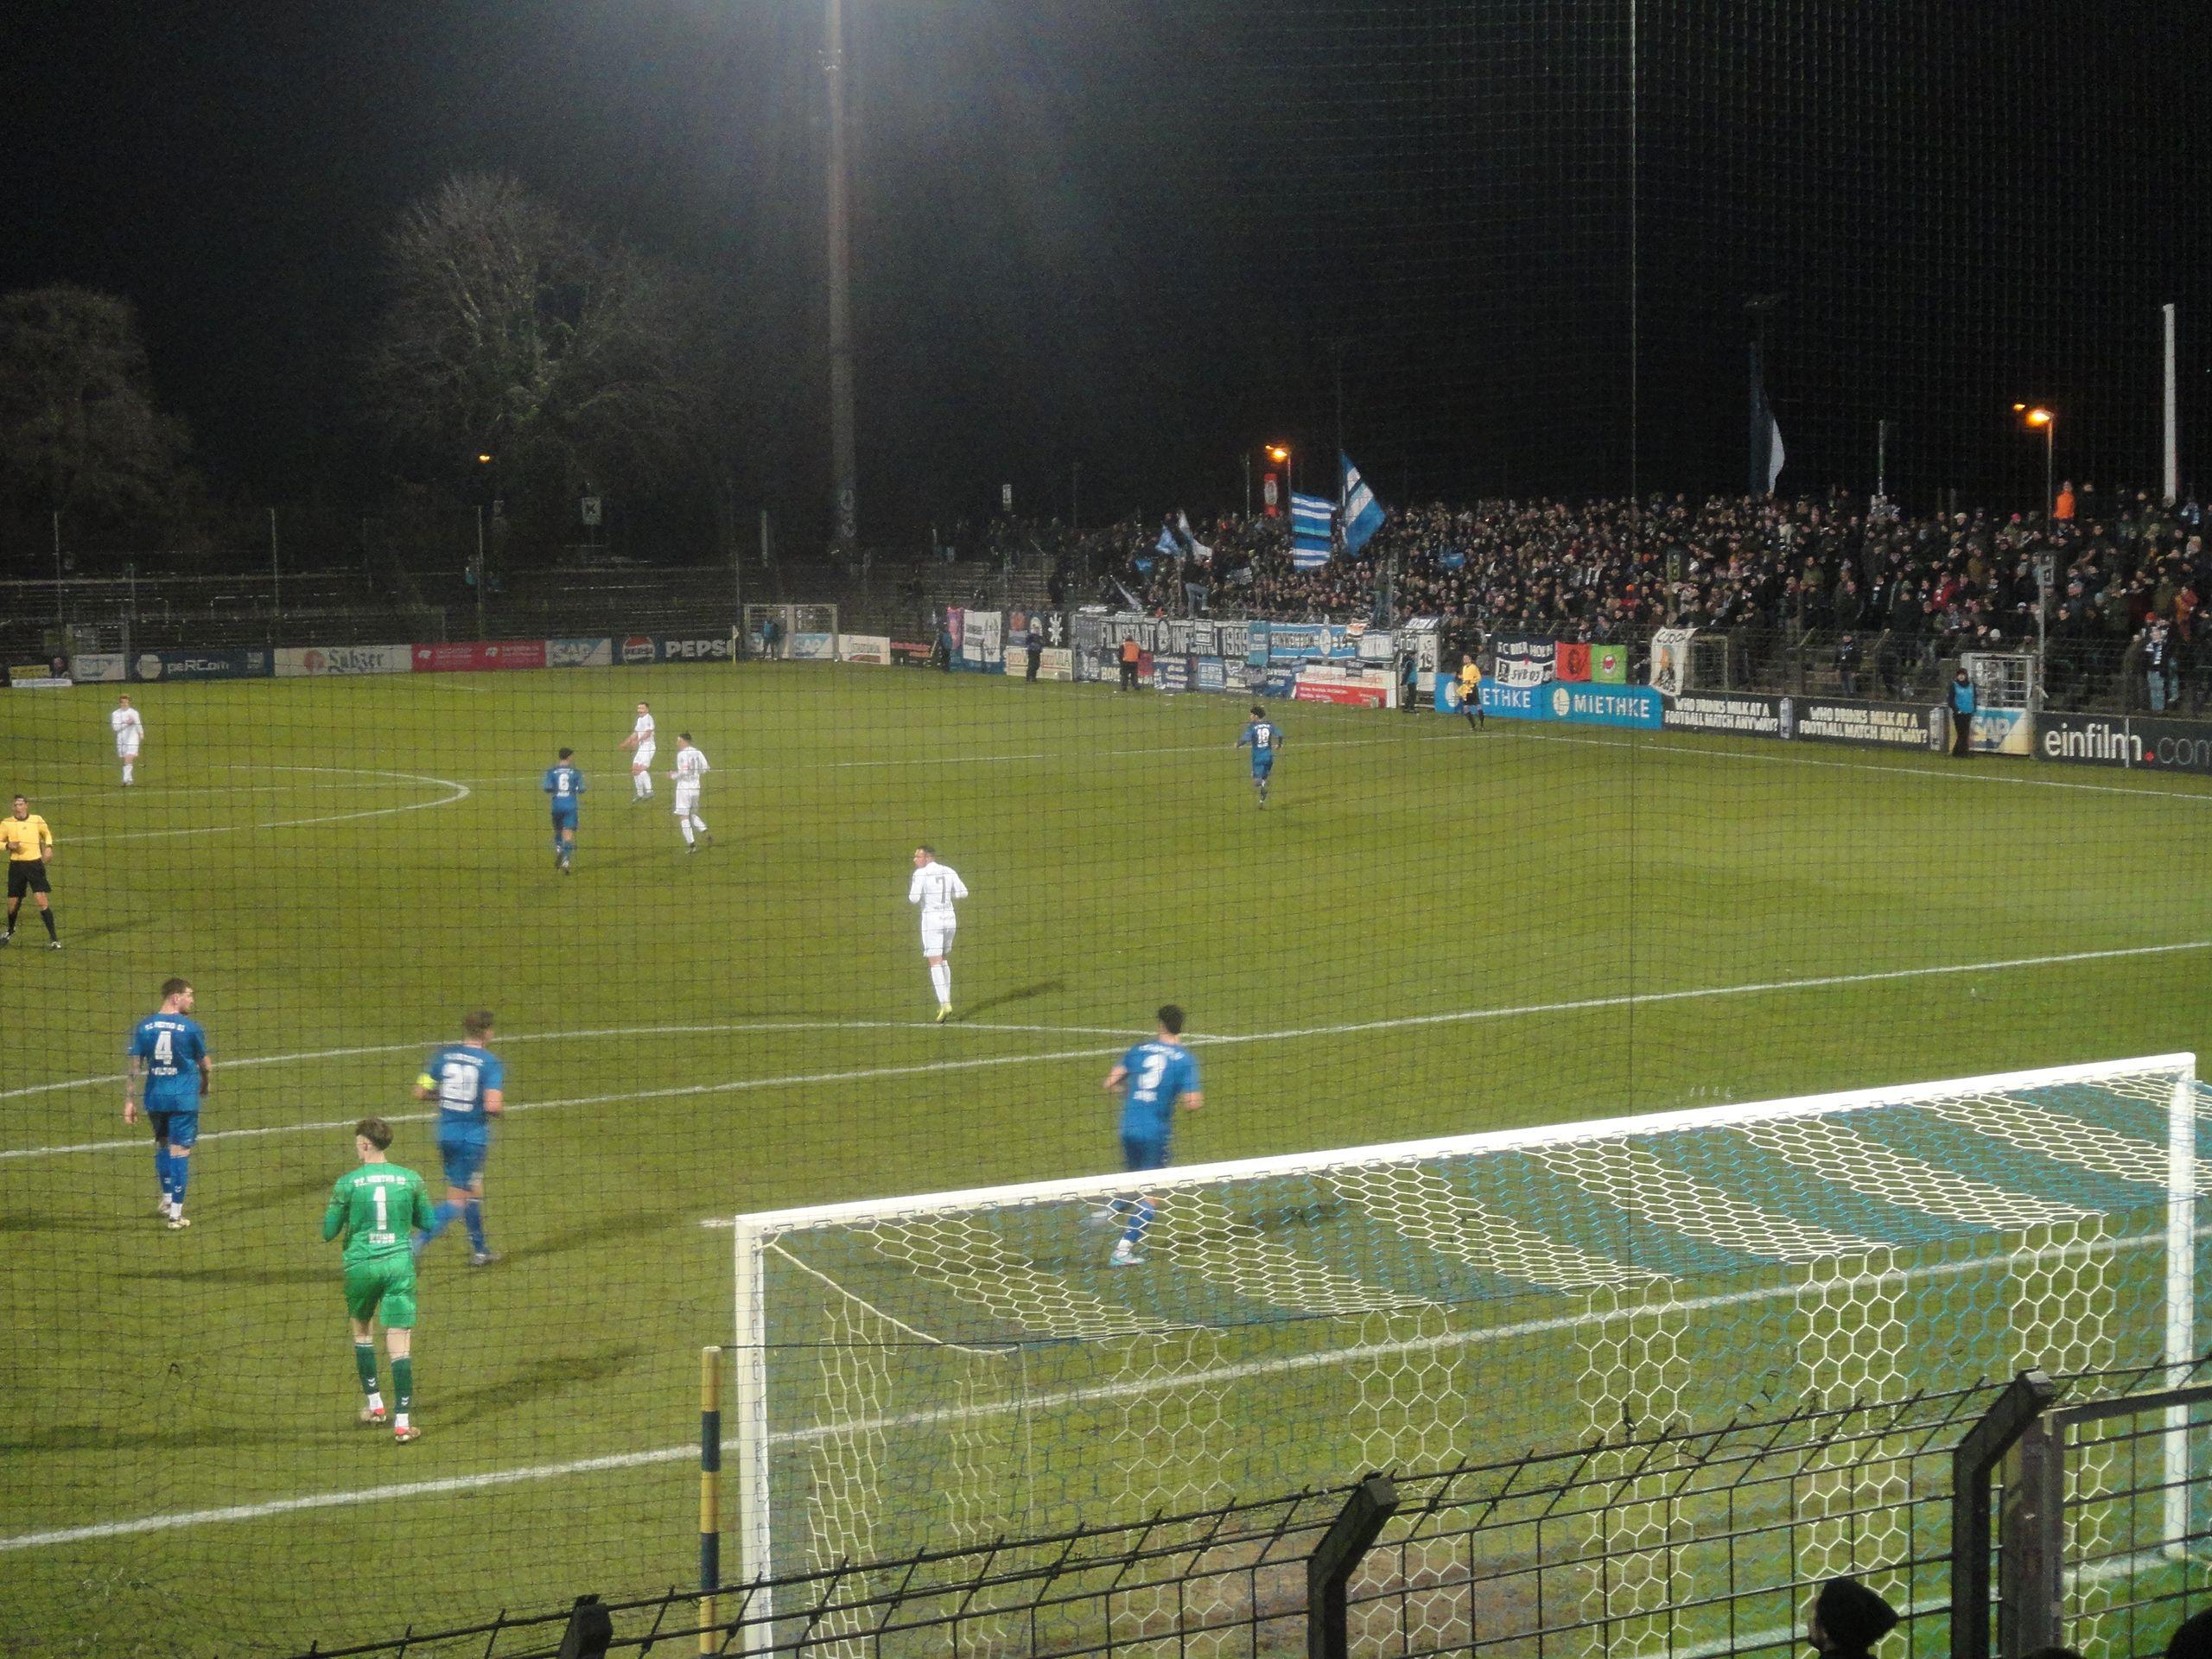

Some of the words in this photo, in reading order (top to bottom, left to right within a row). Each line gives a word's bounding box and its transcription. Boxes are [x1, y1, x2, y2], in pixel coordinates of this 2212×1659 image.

[1481, 689, 1531, 709] ETHKE
[1573, 694, 1650, 718] MIETHKE
[1675, 697, 1694, 711] WHO
[1763, 702, 1770, 717] A
[1664, 710, 1705, 726] FOOTBALL
[1705, 714, 1734, 728] MATCH
[1809, 707, 1833, 721] WHO
[1896, 712, 1910, 728] AT
[1910, 713, 1918, 728] A
[1799, 720, 1844, 736] FOOTBALL
[1844, 723, 1878, 740] MATCH
[936, 875, 946, 904] 7
[155, 1031, 173, 1065] 4
[373, 1185, 387, 1230] 1
